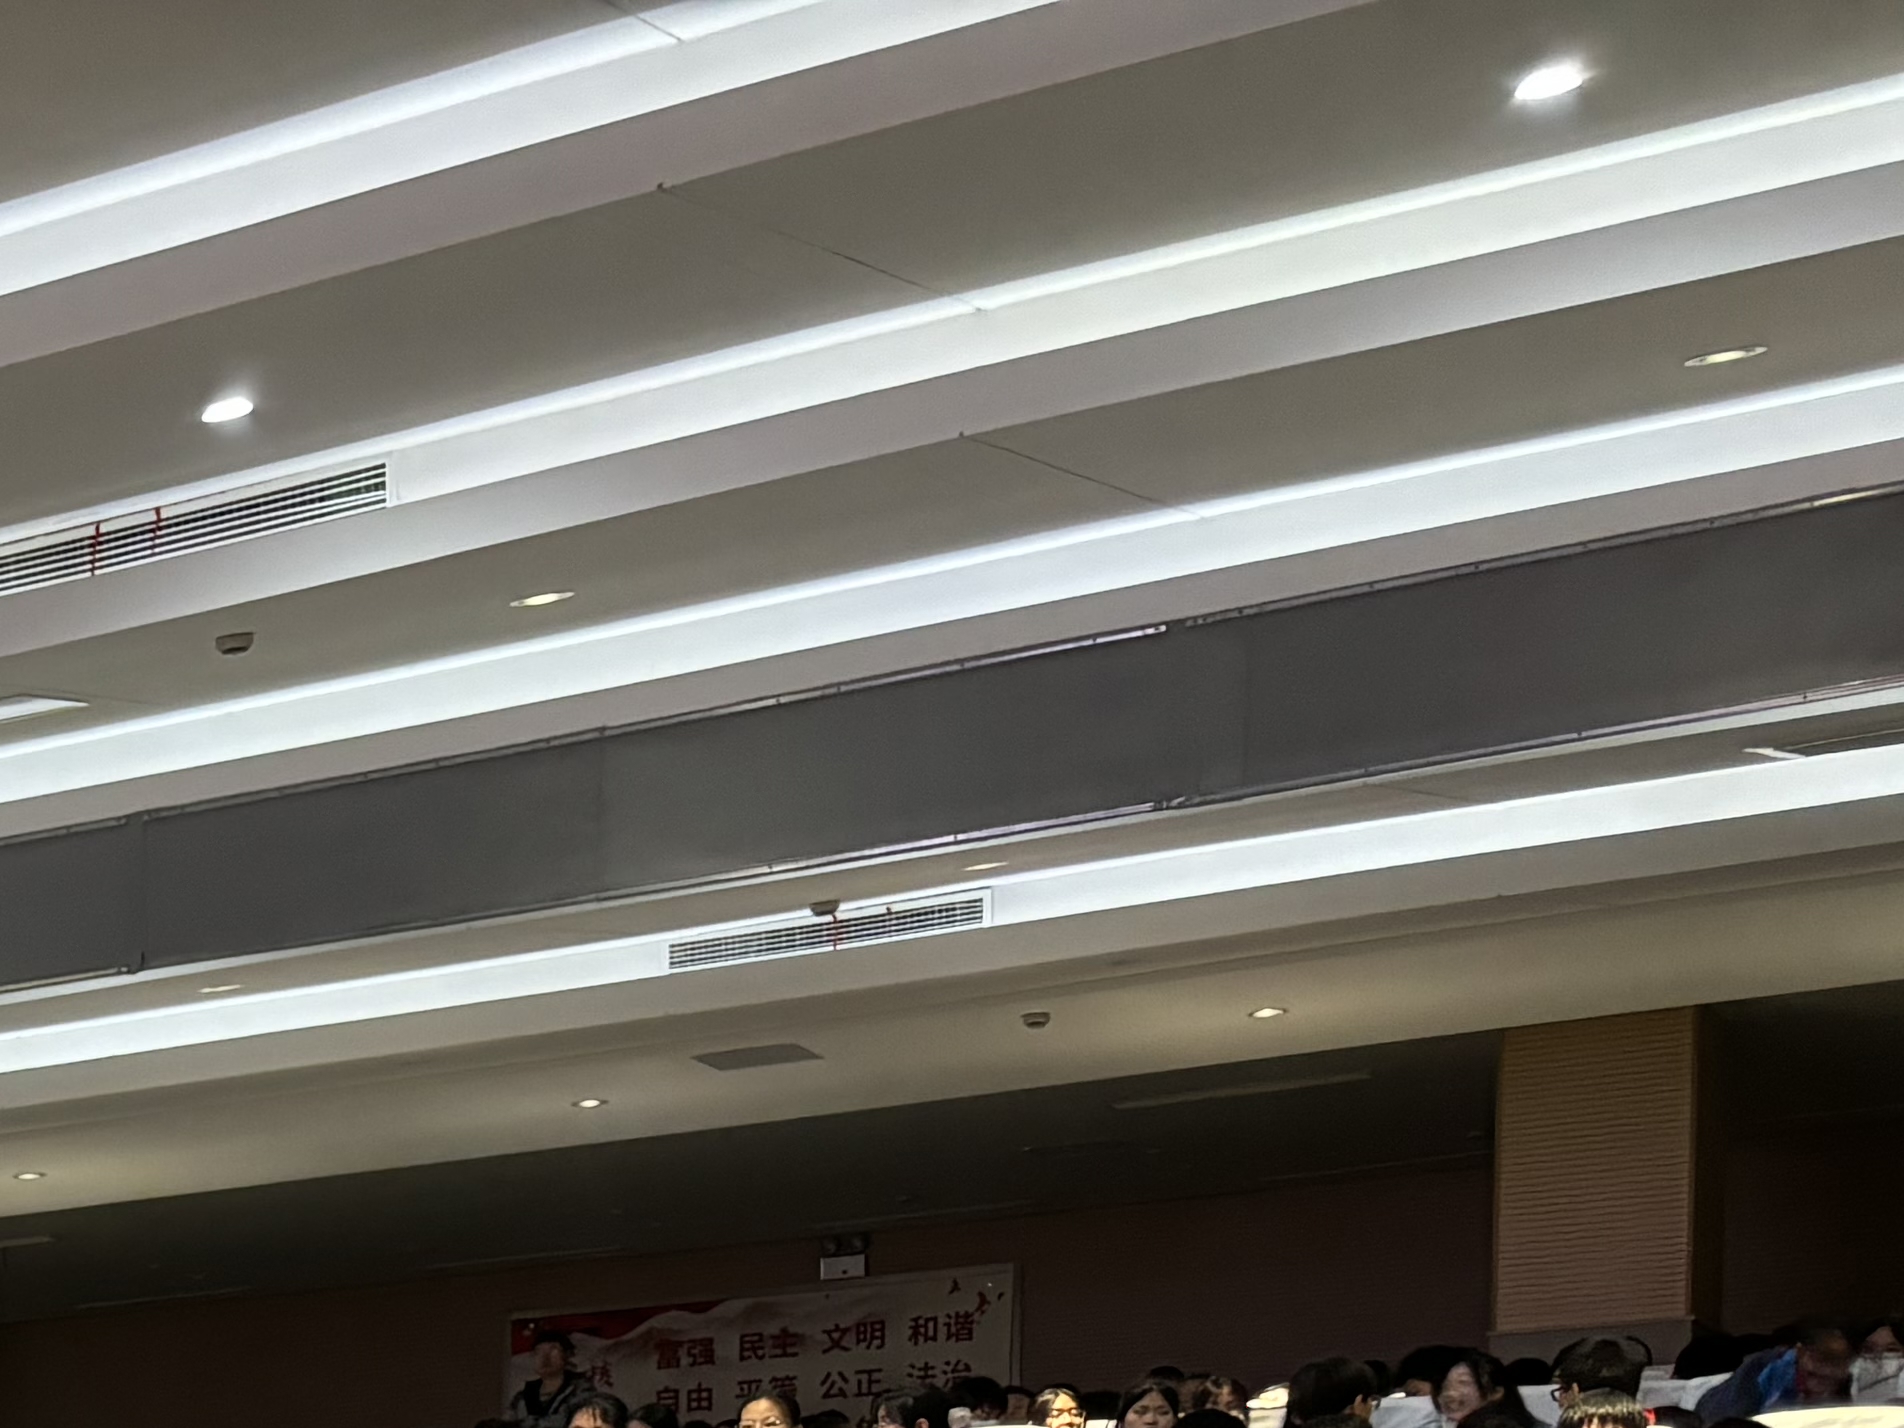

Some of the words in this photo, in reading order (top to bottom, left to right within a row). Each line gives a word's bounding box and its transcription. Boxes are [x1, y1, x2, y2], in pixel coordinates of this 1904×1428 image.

[657, 1337, 716, 1370] 富强
[739, 1328, 799, 1362] 民主
[822, 1319, 886, 1354] 文明
[909, 1312, 974, 1346] 和谐
[656, 1382, 714, 1414] 自由
[820, 1368, 890, 1399] 公正
